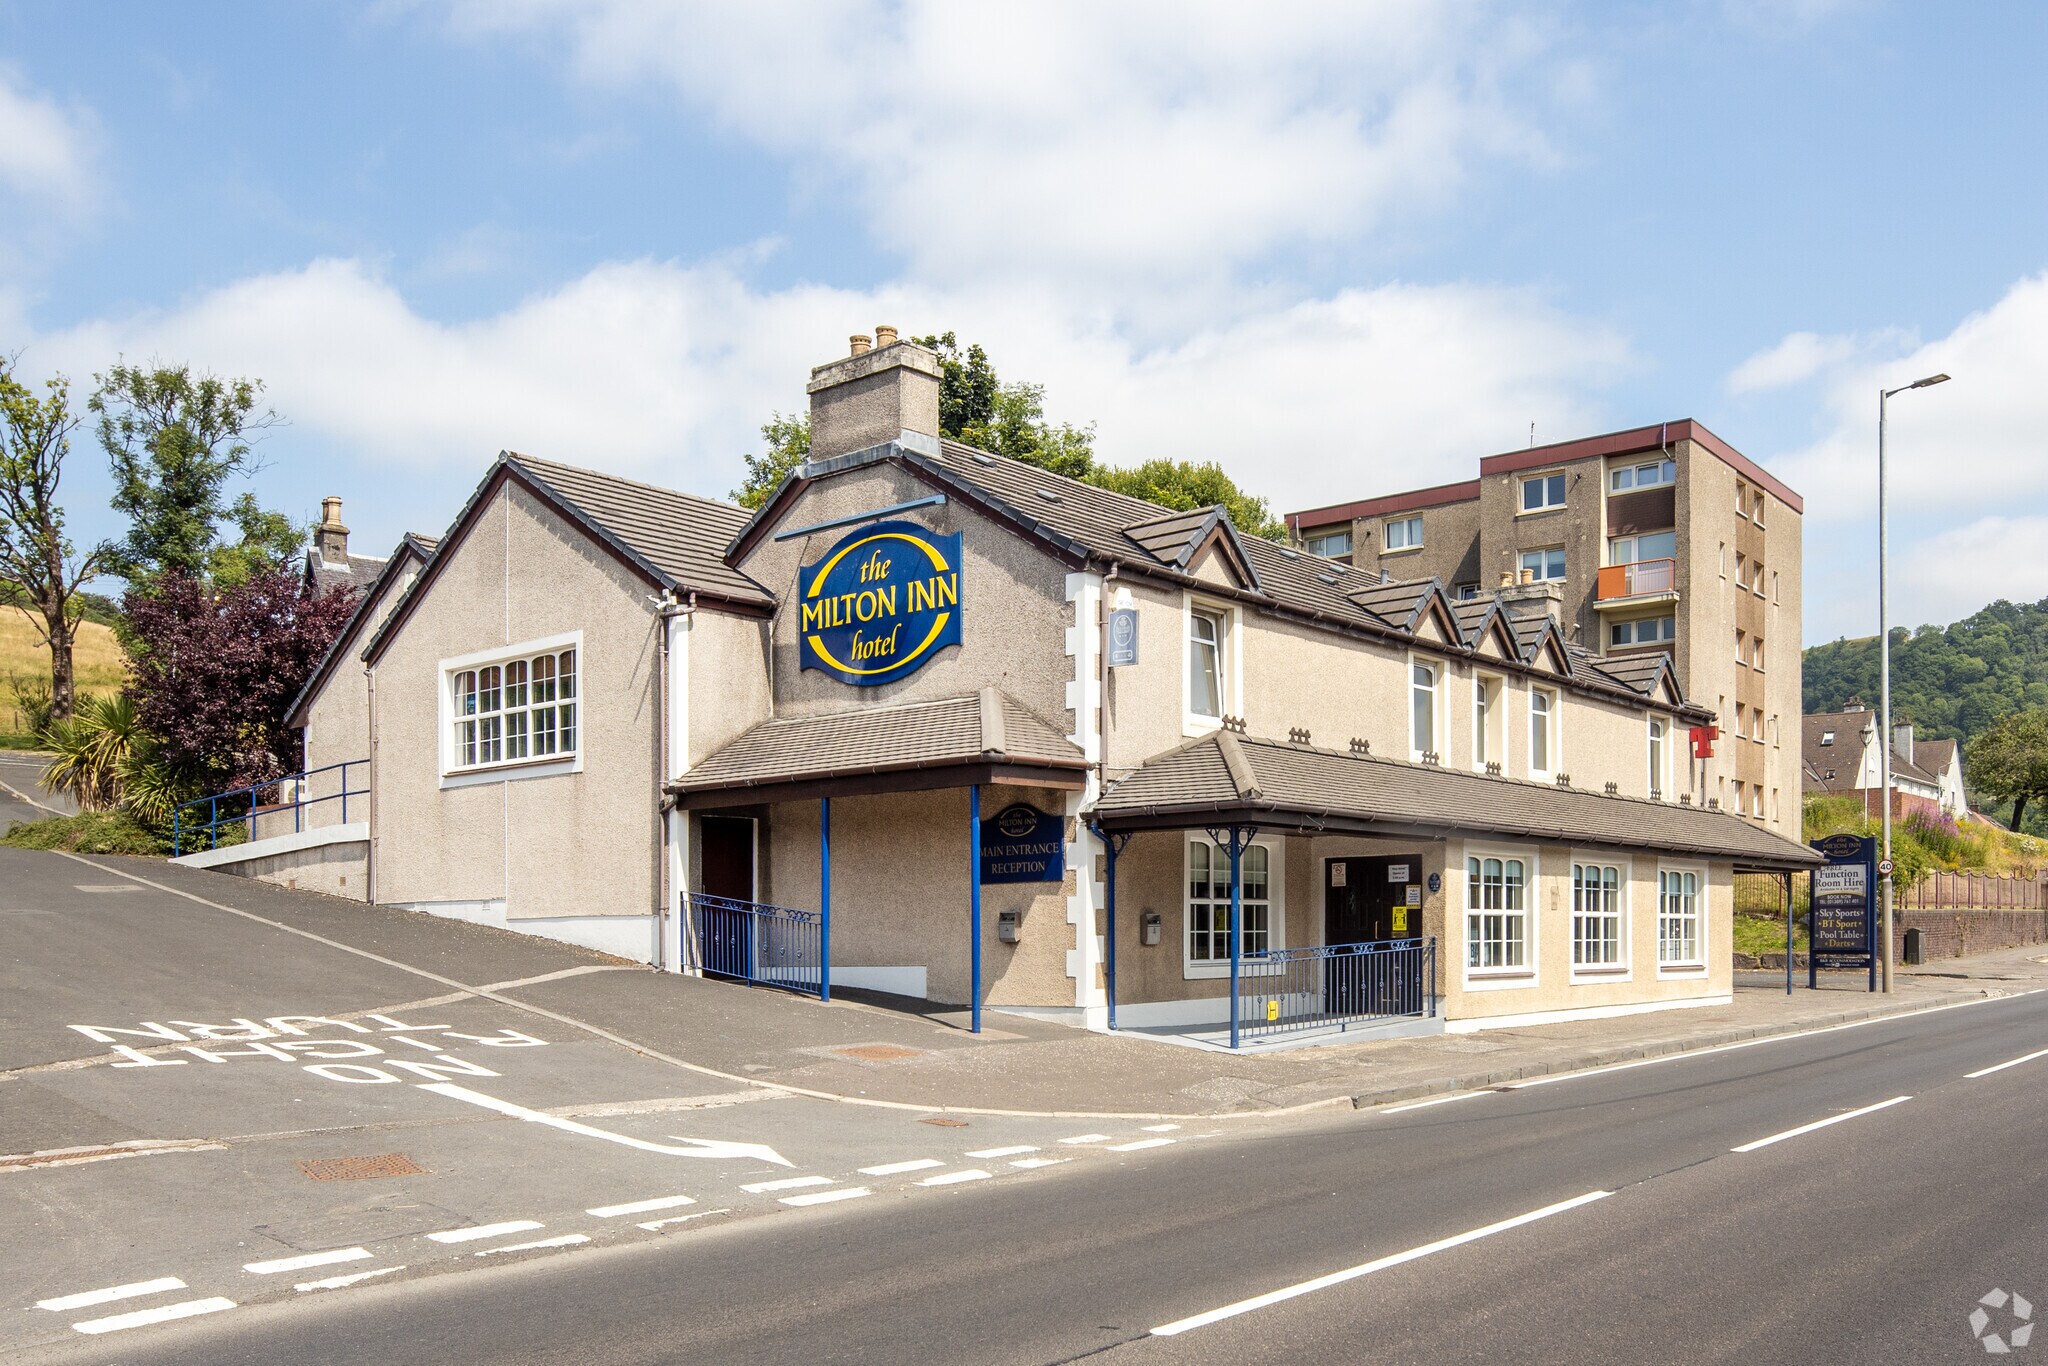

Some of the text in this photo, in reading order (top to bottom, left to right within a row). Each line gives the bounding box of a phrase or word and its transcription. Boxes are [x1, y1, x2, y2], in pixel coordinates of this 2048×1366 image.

[861, 549, 892, 584] the
[801, 573, 958, 633] MILTON INN
[851, 623, 902, 661] hotel
[999, 817, 1038, 827] MILTON INN
[980, 842, 1060, 857] MAIN ENTRANCE
[991, 861, 1046, 874] RECEPTION
[1819, 870, 1859, 879] Function
[1815, 877, 1864, 887] Room Hire
[1819, 909, 1860, 919] Sky Sports
[1822, 919, 1857, 930] BT Sport
[1820, 930, 1860, 939] Pool Table
[1829, 939, 1850, 947] Darts
[66, 1014, 452, 1042] TURN
[111, 1029, 551, 1068] RIGHT
[302, 1054, 502, 1084] NO
